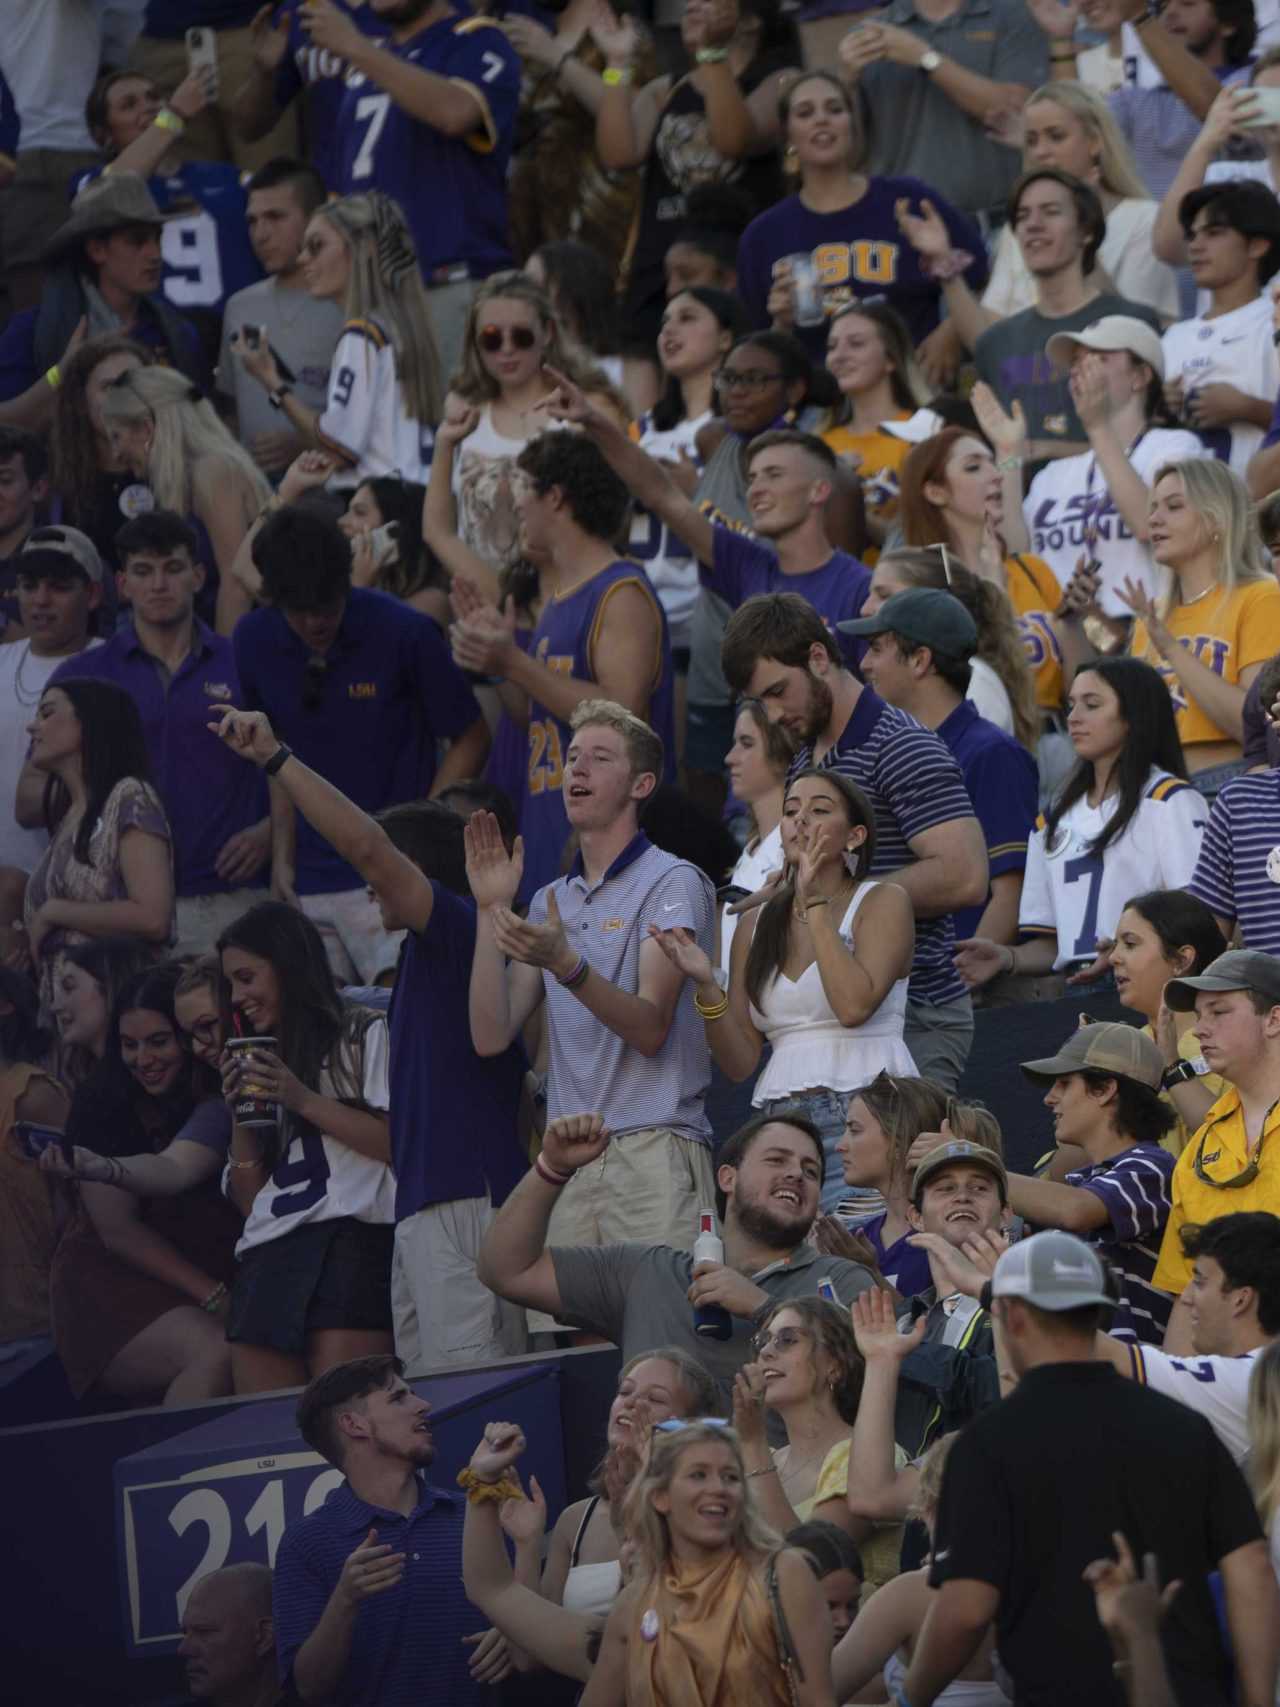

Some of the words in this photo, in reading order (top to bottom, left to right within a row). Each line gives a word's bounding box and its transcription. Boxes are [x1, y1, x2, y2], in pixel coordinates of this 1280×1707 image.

[481, 52, 506, 83] 7
[351, 94, 391, 181] 7
[160, 209, 225, 308] 9
[811, 239, 899, 286] SU
[1063, 850, 1105, 957] 7
[269, 1135, 332, 1219] 9
[1192, 1149, 1222, 1169] SU
